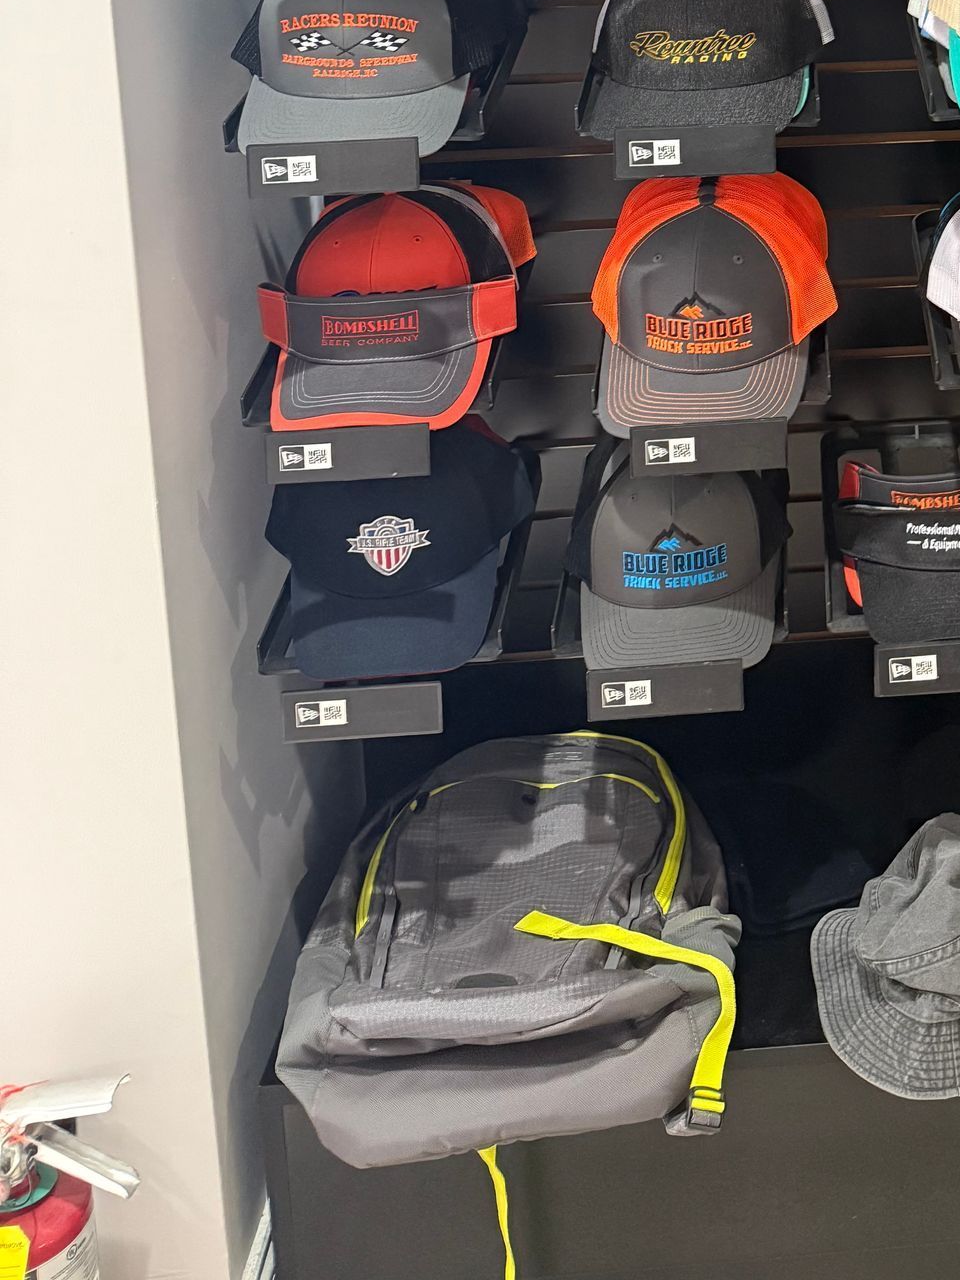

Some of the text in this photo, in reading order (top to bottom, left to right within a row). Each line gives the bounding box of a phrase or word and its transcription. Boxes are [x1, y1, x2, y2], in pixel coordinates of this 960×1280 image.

[281, 12, 418, 32] RACERS REUNION
[630, 29, 756, 60] Rountree
[359, 53, 418, 68] SPEEDWAY
[670, 51, 747, 64] RACING
[656, 144, 676, 152] NEW
[656, 152, 676, 160] ERA
[291, 160, 312, 168] NEW
[291, 168, 312, 177] ERA
[325, 315, 417, 335] BOMBSHELL
[646, 313, 753, 341] BLUE RIDGE
[357, 334, 419, 346] COMPANY
[646, 335, 684, 354] TRUCK
[622, 543, 728, 575] BLUE RIDGE
[623, 574, 661, 590] TRUCK
